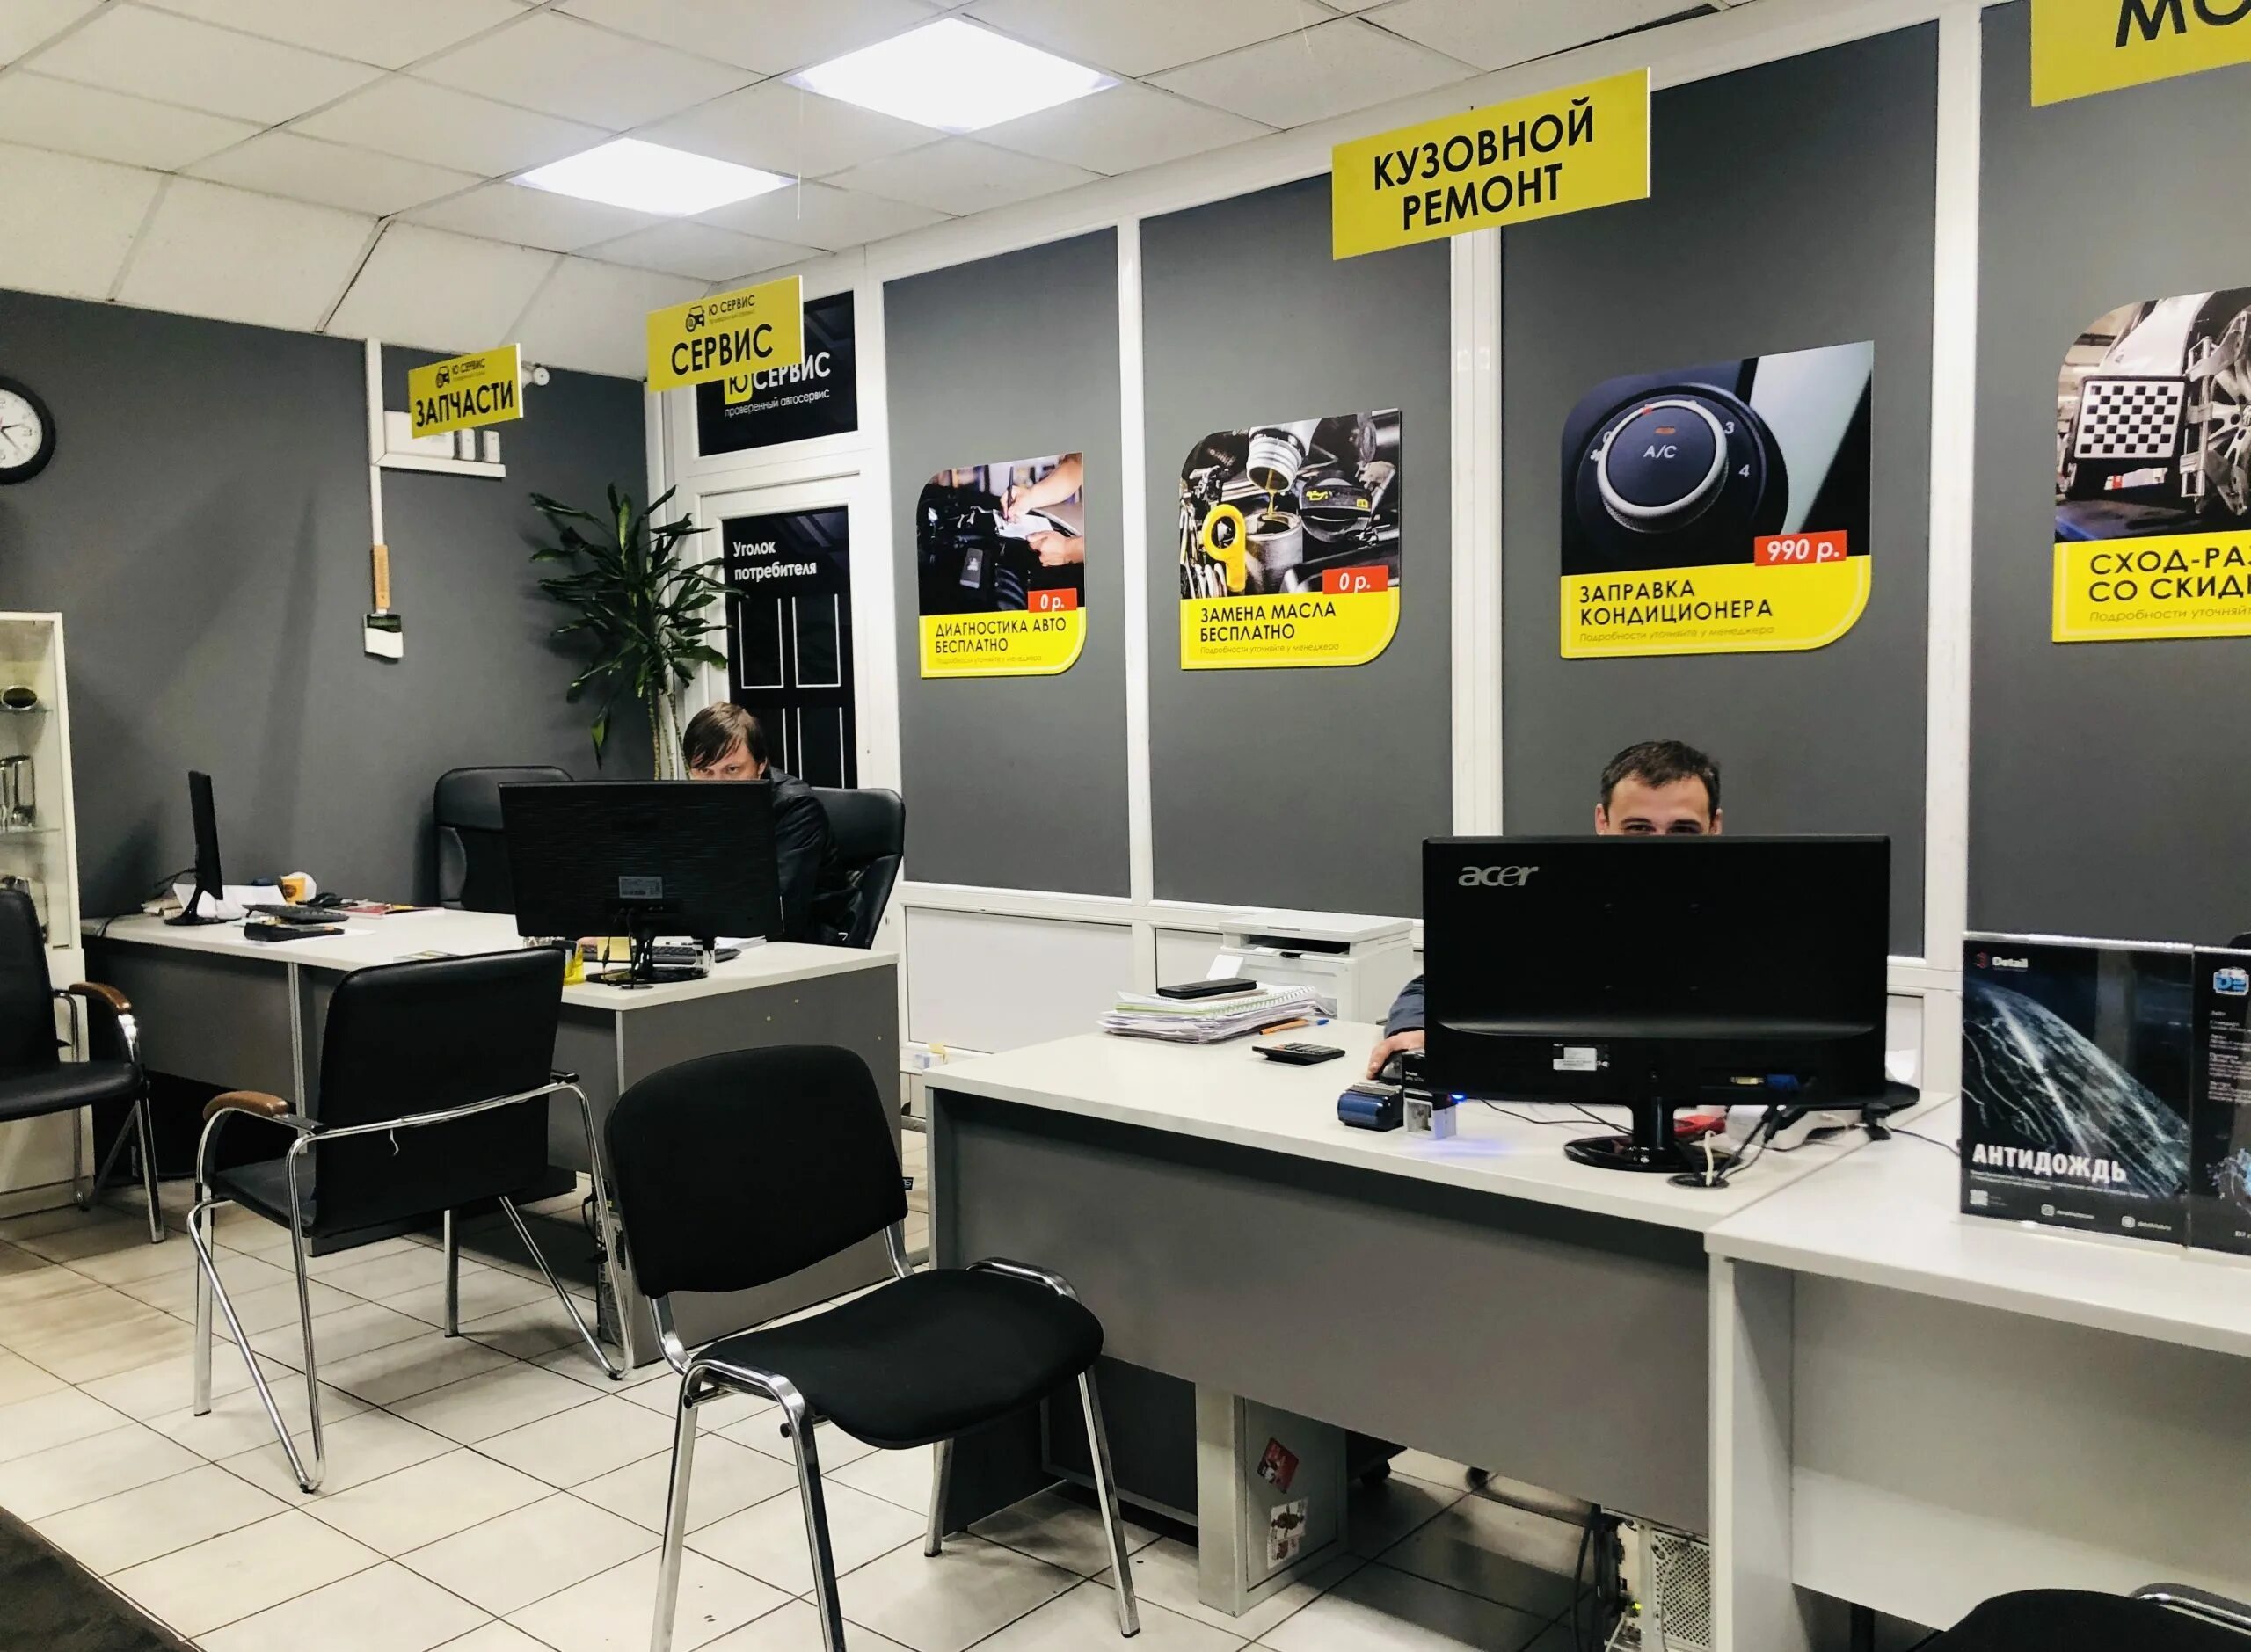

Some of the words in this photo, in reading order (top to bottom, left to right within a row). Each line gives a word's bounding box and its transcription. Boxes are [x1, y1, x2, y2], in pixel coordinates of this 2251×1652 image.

[1374, 96, 1593, 190] КУЗОВНОЙ
[1403, 163, 1563, 230] РЕМОНТ
[708, 303, 718, 316] Ю
[720, 295, 755, 313] СЕРВИС
[671, 323, 774, 375] СЕРВИС
[753, 351, 831, 390] СЕРВИС
[416, 380, 514, 427] ЗАПЧАСТИ
[725, 397, 779, 418] проверенный
[780, 389, 830, 406] автосервис
[1723, 421, 1735, 434] 3
[1643, 444, 1678, 459] A/C
[1739, 463, 1751, 477] 4
[732, 541, 776, 557] Уголок
[1767, 538, 1810, 562] 990
[1816, 541, 1840, 563] р.
[734, 561, 817, 583] потребителя
[1338, 572, 1350, 591] 0
[1354, 575, 1371, 593] р.
[1580, 579, 1695, 604] ЗАПРАВКА
[2088, 579, 2138, 602] СО
[2150, 574, 2251, 600] СКИД
[1039, 593, 1049, 609] 0
[1052, 596, 1065, 612] р.
[1201, 605, 1266, 623] ЗАМЕНА
[1271, 601, 1337, 620] МАСЛА
[1580, 599, 1774, 626] КОНДИЦИОНЕРА
[2089, 609, 2187, 622] Подробности
[936, 619, 1028, 638] ДИАГНОСТИКА
[1032, 617, 1067, 632] АВТО
[1200, 623, 1295, 643] БЕСПЛАТНО
[1579, 630, 1647, 643] Подробности
[936, 637, 1009, 654] БЕСПЛАТНО
[1200, 644, 1249, 655] Подробности
[1249, 644, 1285, 654] уточняйте
[1292, 643, 1339, 651] менеджера
[1458, 865, 1540, 886] acer
[1972, 1143, 2127, 1184] АНТИДОЖДЬ
